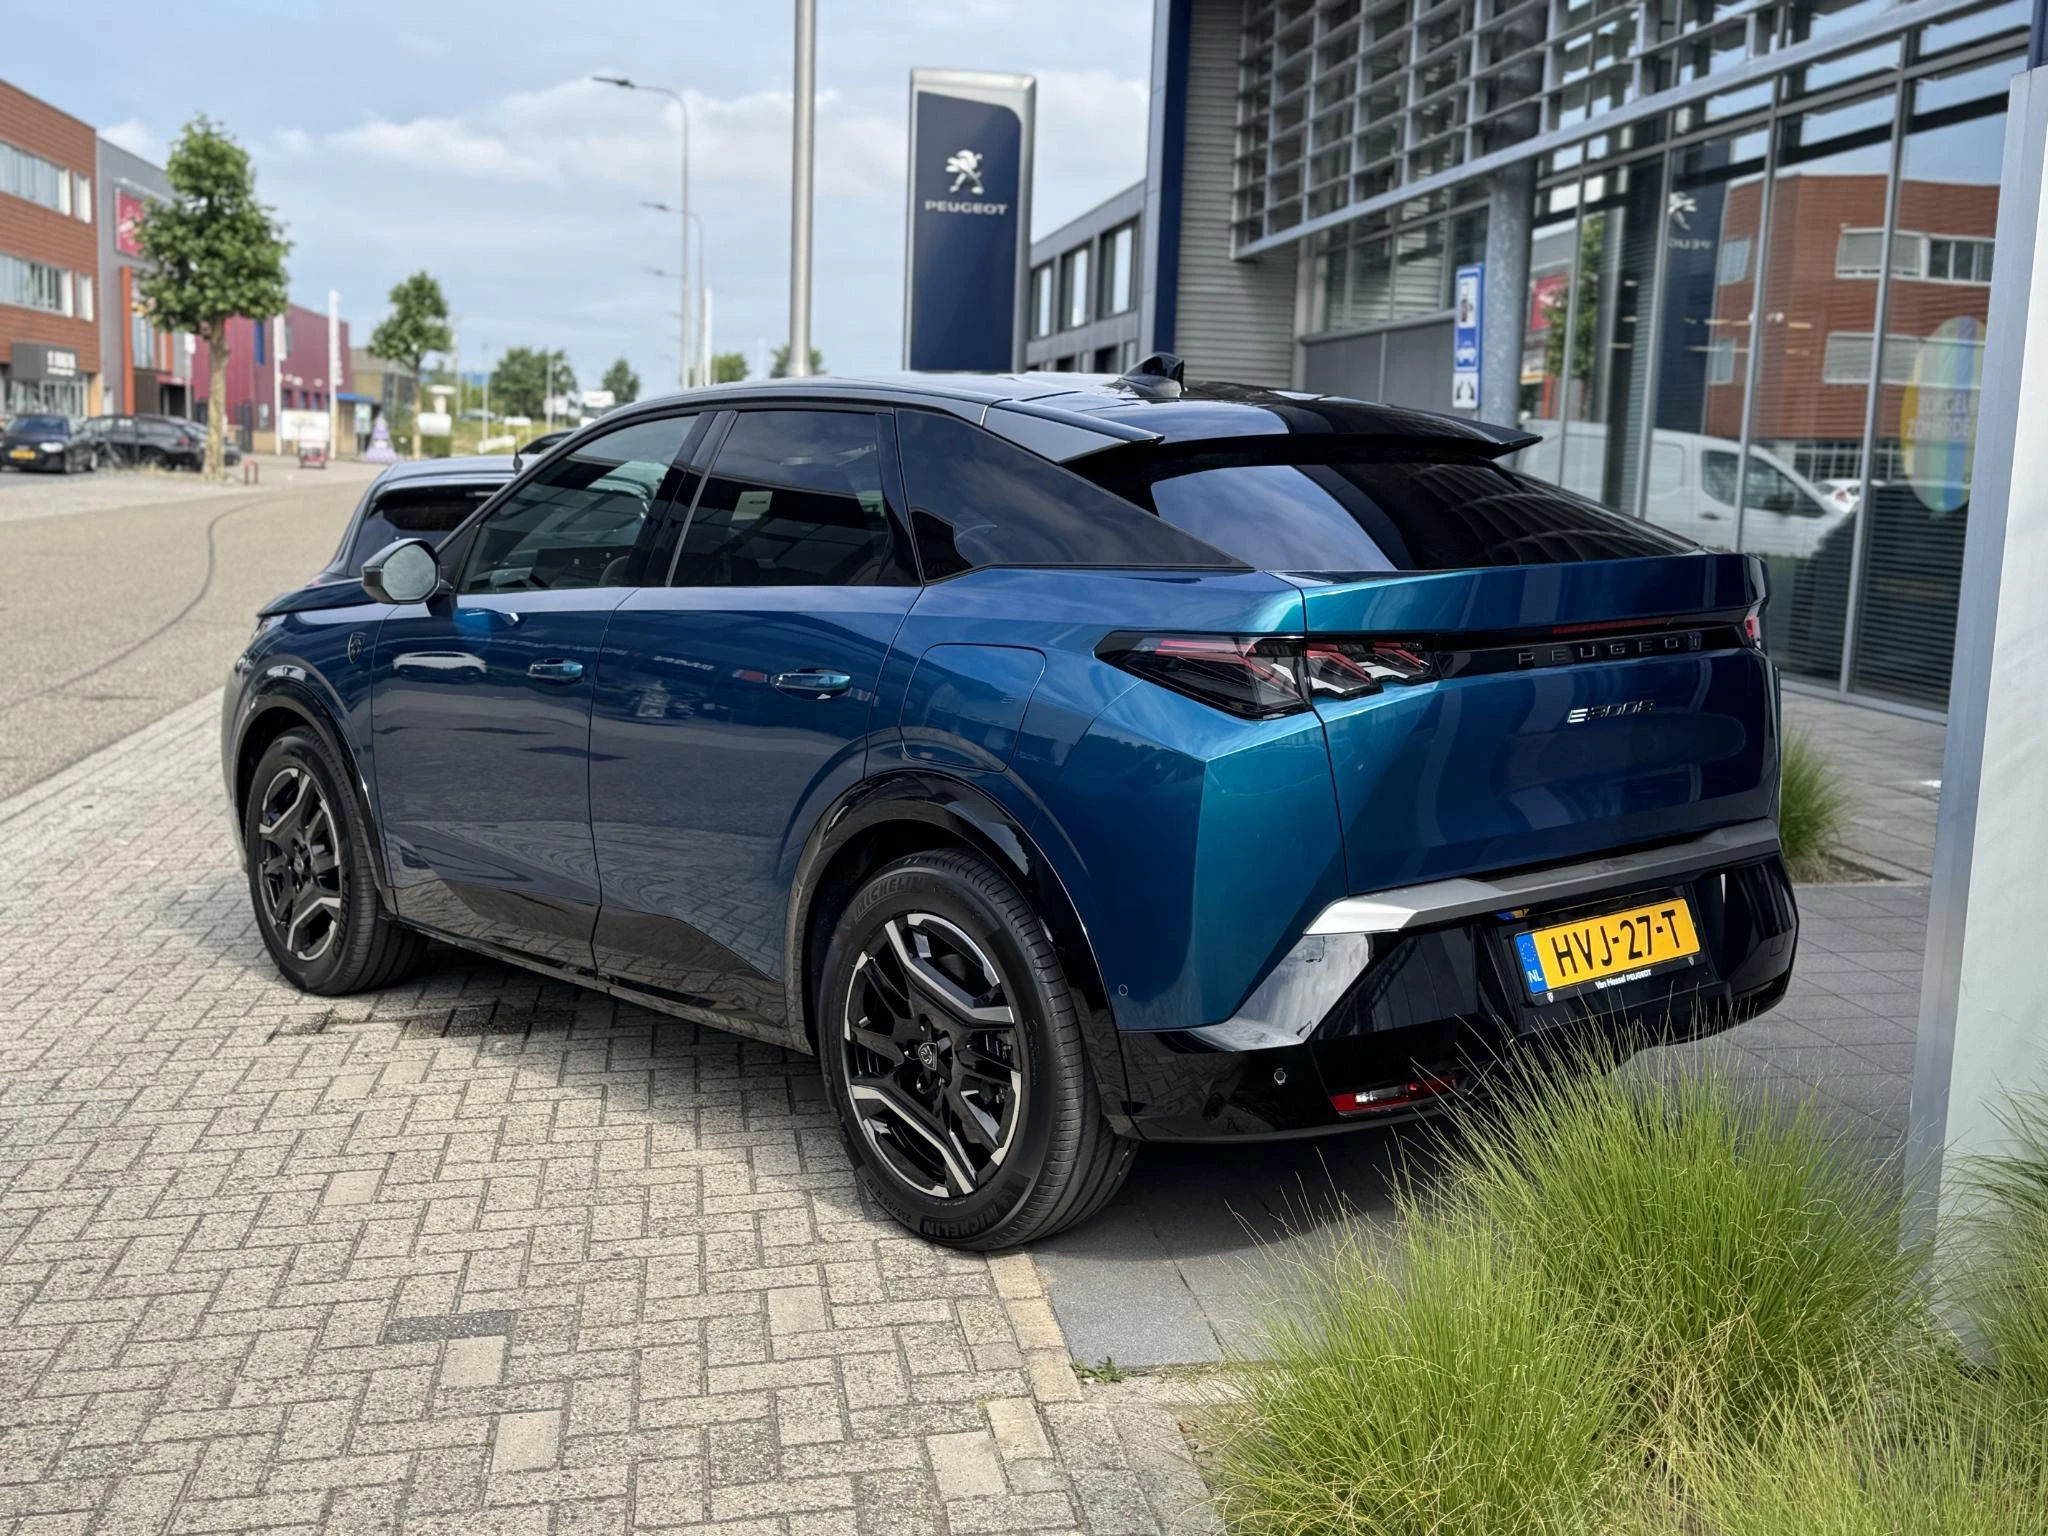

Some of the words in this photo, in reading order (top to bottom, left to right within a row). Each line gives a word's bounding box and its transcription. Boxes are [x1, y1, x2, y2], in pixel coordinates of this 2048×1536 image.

[925, 200, 1008, 215] PEUGEOT
[1518, 632, 1700, 665] PEUGEOT
[857, 876, 929, 915] MICHELIN
[1551, 909, 1681, 977] HVJ-27-T
[1527, 969, 1543, 983] NL
[1595, 980, 1607, 990] Van
[1626, 969, 1652, 982] PEUGEOT
[923, 1204, 999, 1237] MICHELIN
